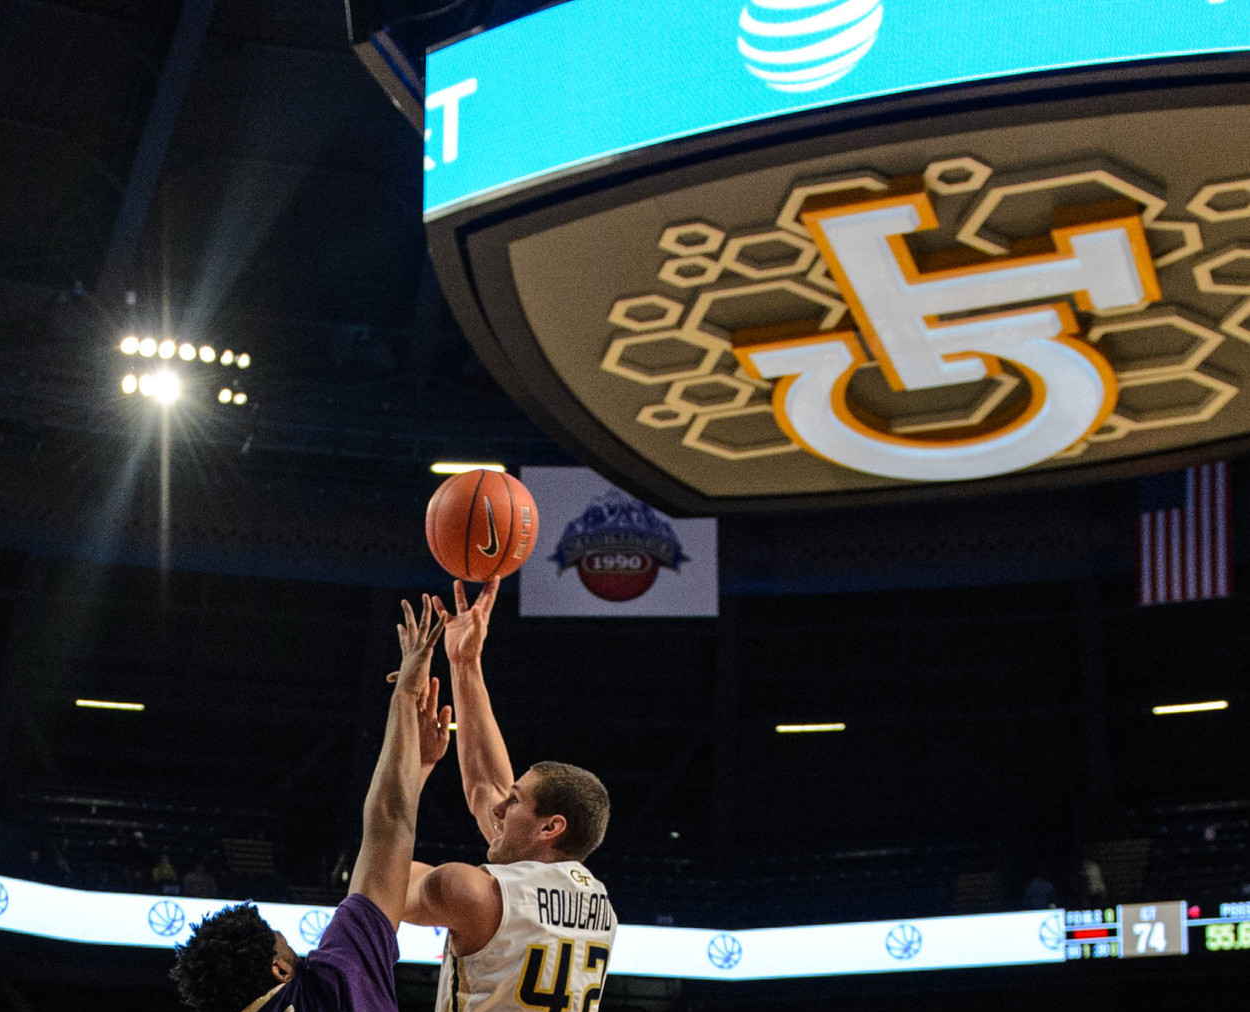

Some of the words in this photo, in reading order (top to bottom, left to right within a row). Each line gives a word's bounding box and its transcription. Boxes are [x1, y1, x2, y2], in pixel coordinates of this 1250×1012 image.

[424, 77, 478, 171] T
[593, 553, 643, 570] 1990
[570, 869, 591, 886] GT
[1133, 922, 1167, 954] 74
